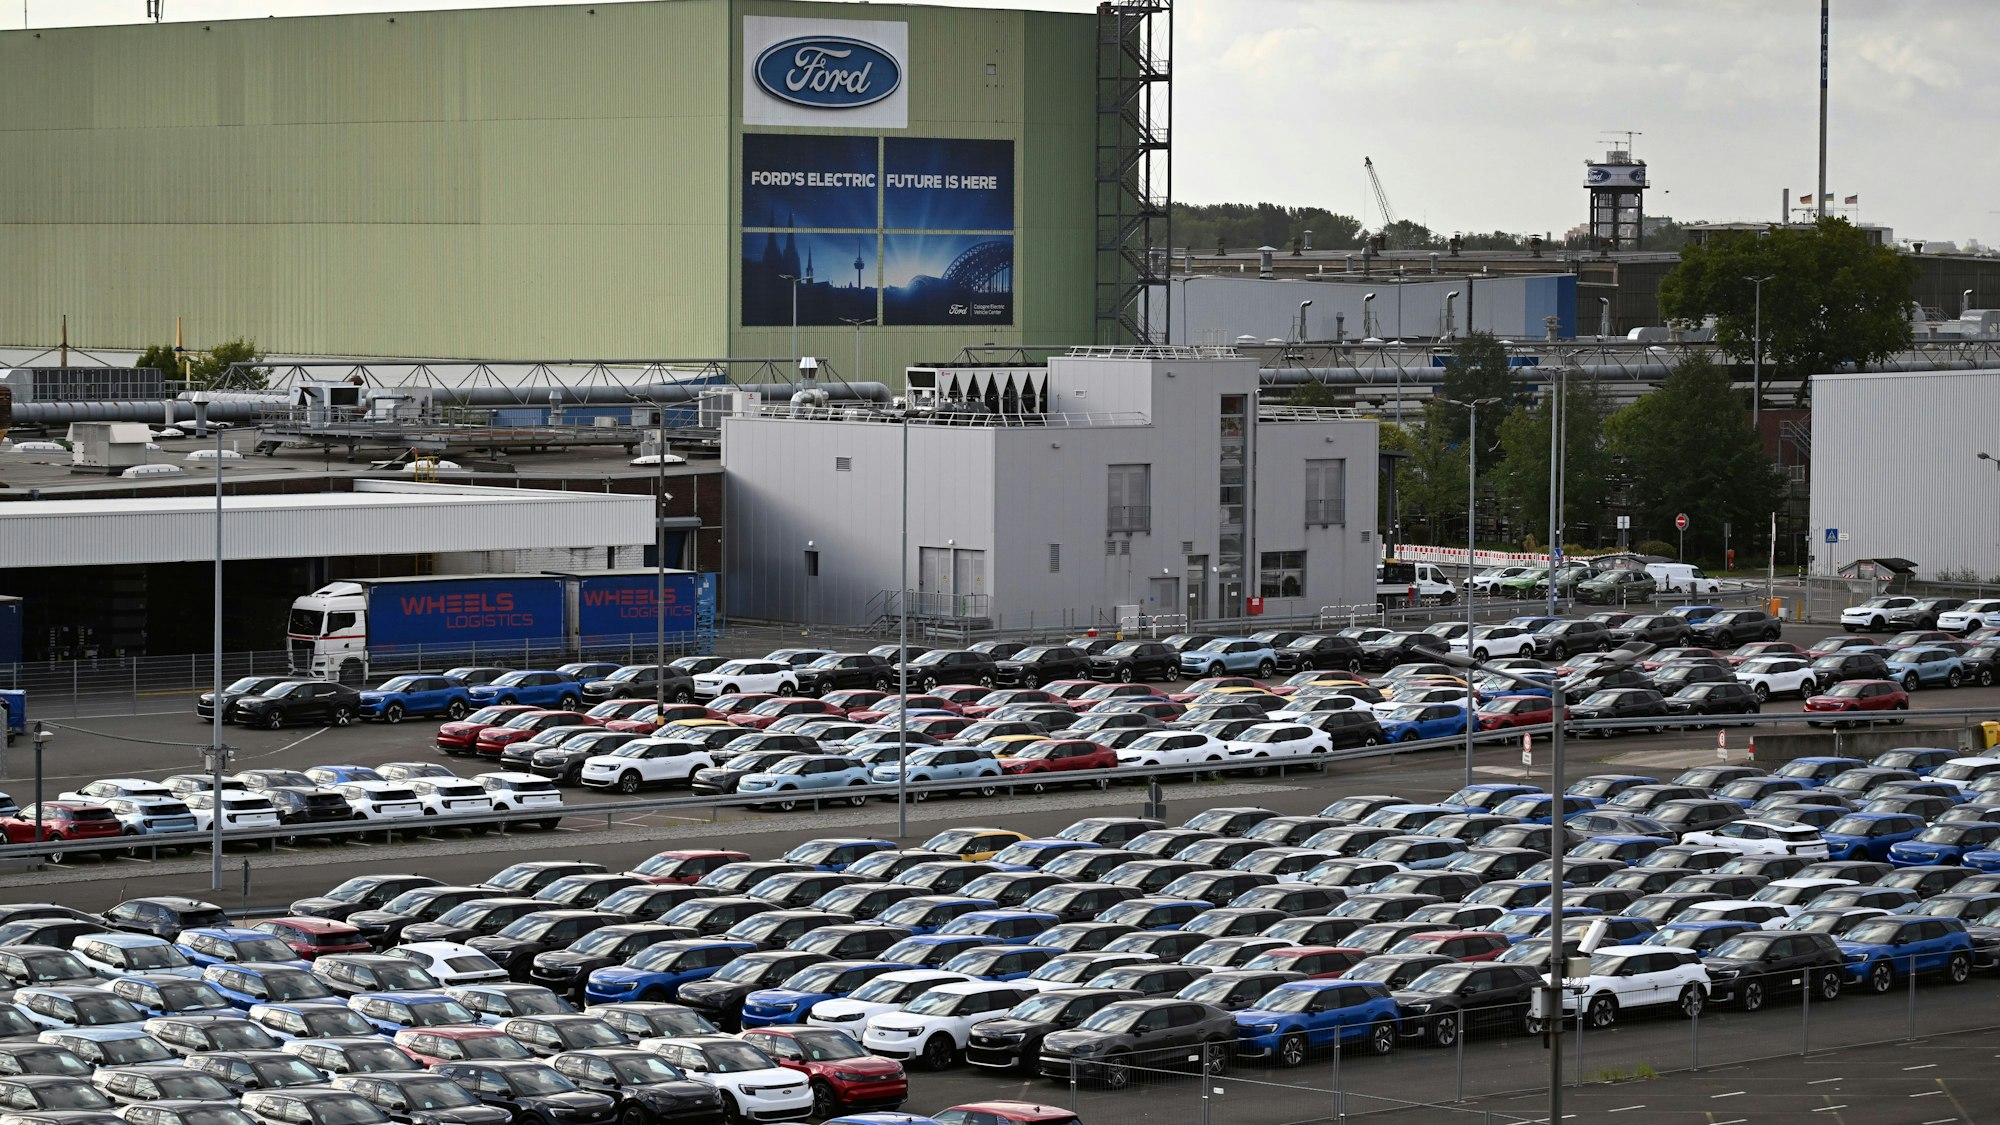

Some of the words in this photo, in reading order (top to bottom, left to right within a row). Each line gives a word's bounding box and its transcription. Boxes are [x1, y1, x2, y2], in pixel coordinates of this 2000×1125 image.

[785, 46, 873, 94] Ford
[751, 171, 805, 186] FORD'S
[807, 172, 876, 188] ELECTRIC
[886, 174, 942, 188] FUTURE
[945, 175, 959, 189] IS
[961, 176, 997, 190] HERE
[949, 304, 968, 315] Ford
[401, 593, 514, 615] WHEELS
[583, 588, 677, 606] WHEELS
[446, 613, 534, 628] LOGISTICS
[621, 605, 693, 618] LOGISTICS
